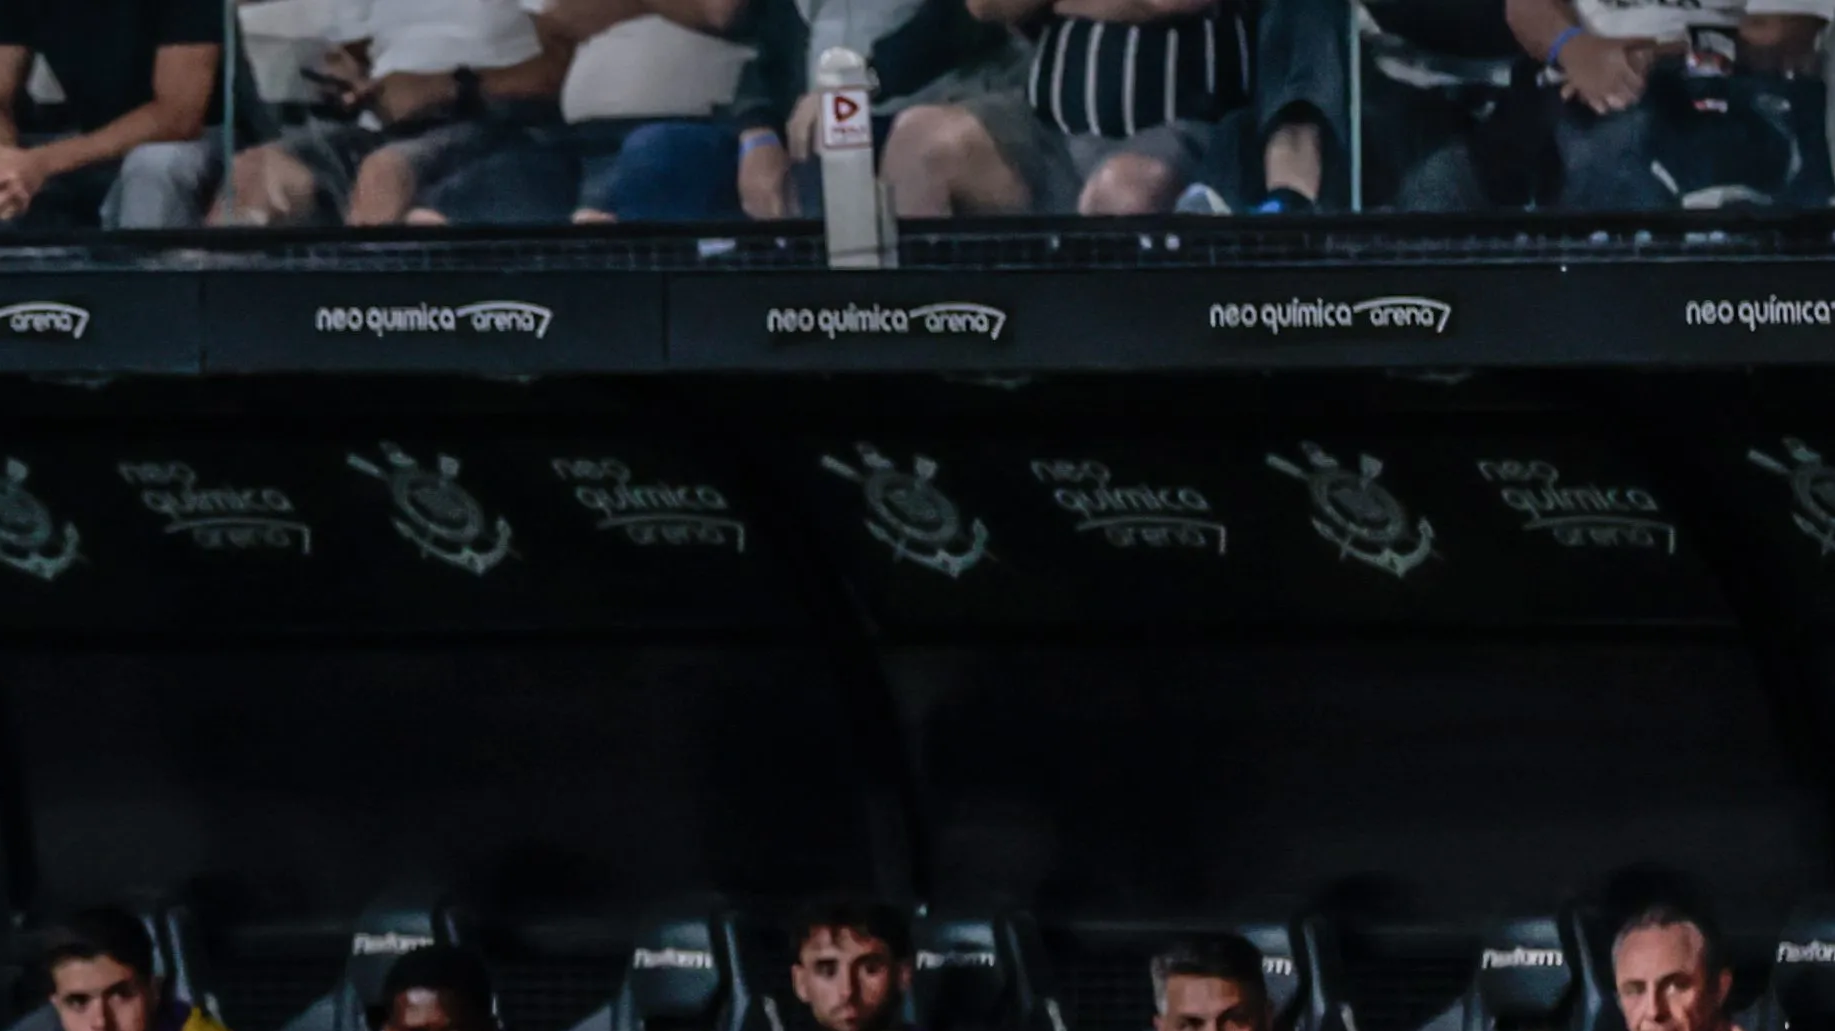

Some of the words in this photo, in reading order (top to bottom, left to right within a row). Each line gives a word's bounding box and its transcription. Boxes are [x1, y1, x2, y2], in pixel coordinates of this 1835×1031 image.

[9, 312, 73, 333] arena
[315, 306, 364, 332] neo
[471, 310, 535, 333] arena
[766, 307, 814, 333] neo
[817, 301, 909, 340] química
[924, 311, 990, 333] arena
[1209, 302, 1258, 329] neo
[1261, 297, 1353, 336] química
[1370, 305, 1435, 327] arena
[1685, 300, 1734, 325] neo
[1737, 293, 1831, 332] química
